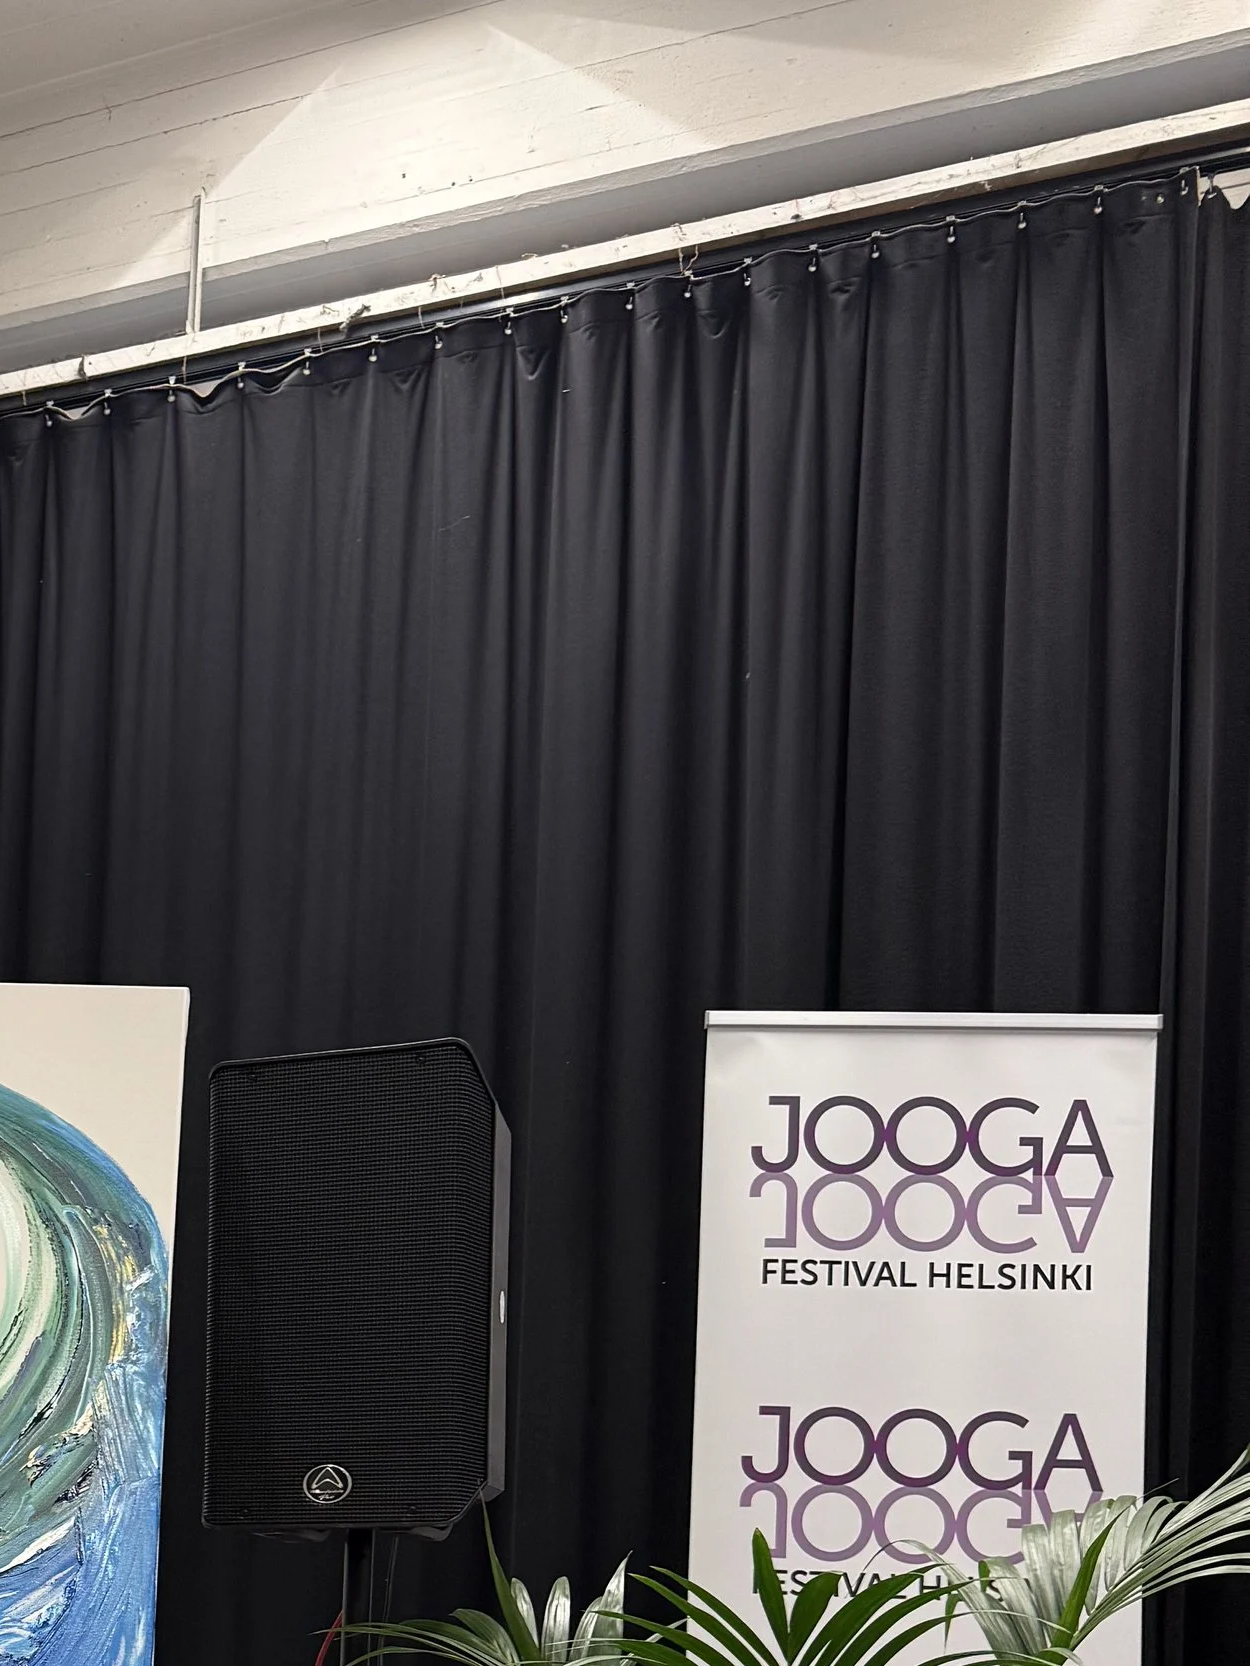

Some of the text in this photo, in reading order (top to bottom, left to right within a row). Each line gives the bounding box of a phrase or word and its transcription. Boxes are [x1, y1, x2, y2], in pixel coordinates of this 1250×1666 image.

[751, 1096, 1114, 1178] JOOGA
[761, 1258, 1093, 1291] FESTIVAL HELSINKI
[741, 1406, 1104, 1492] JOOGA
